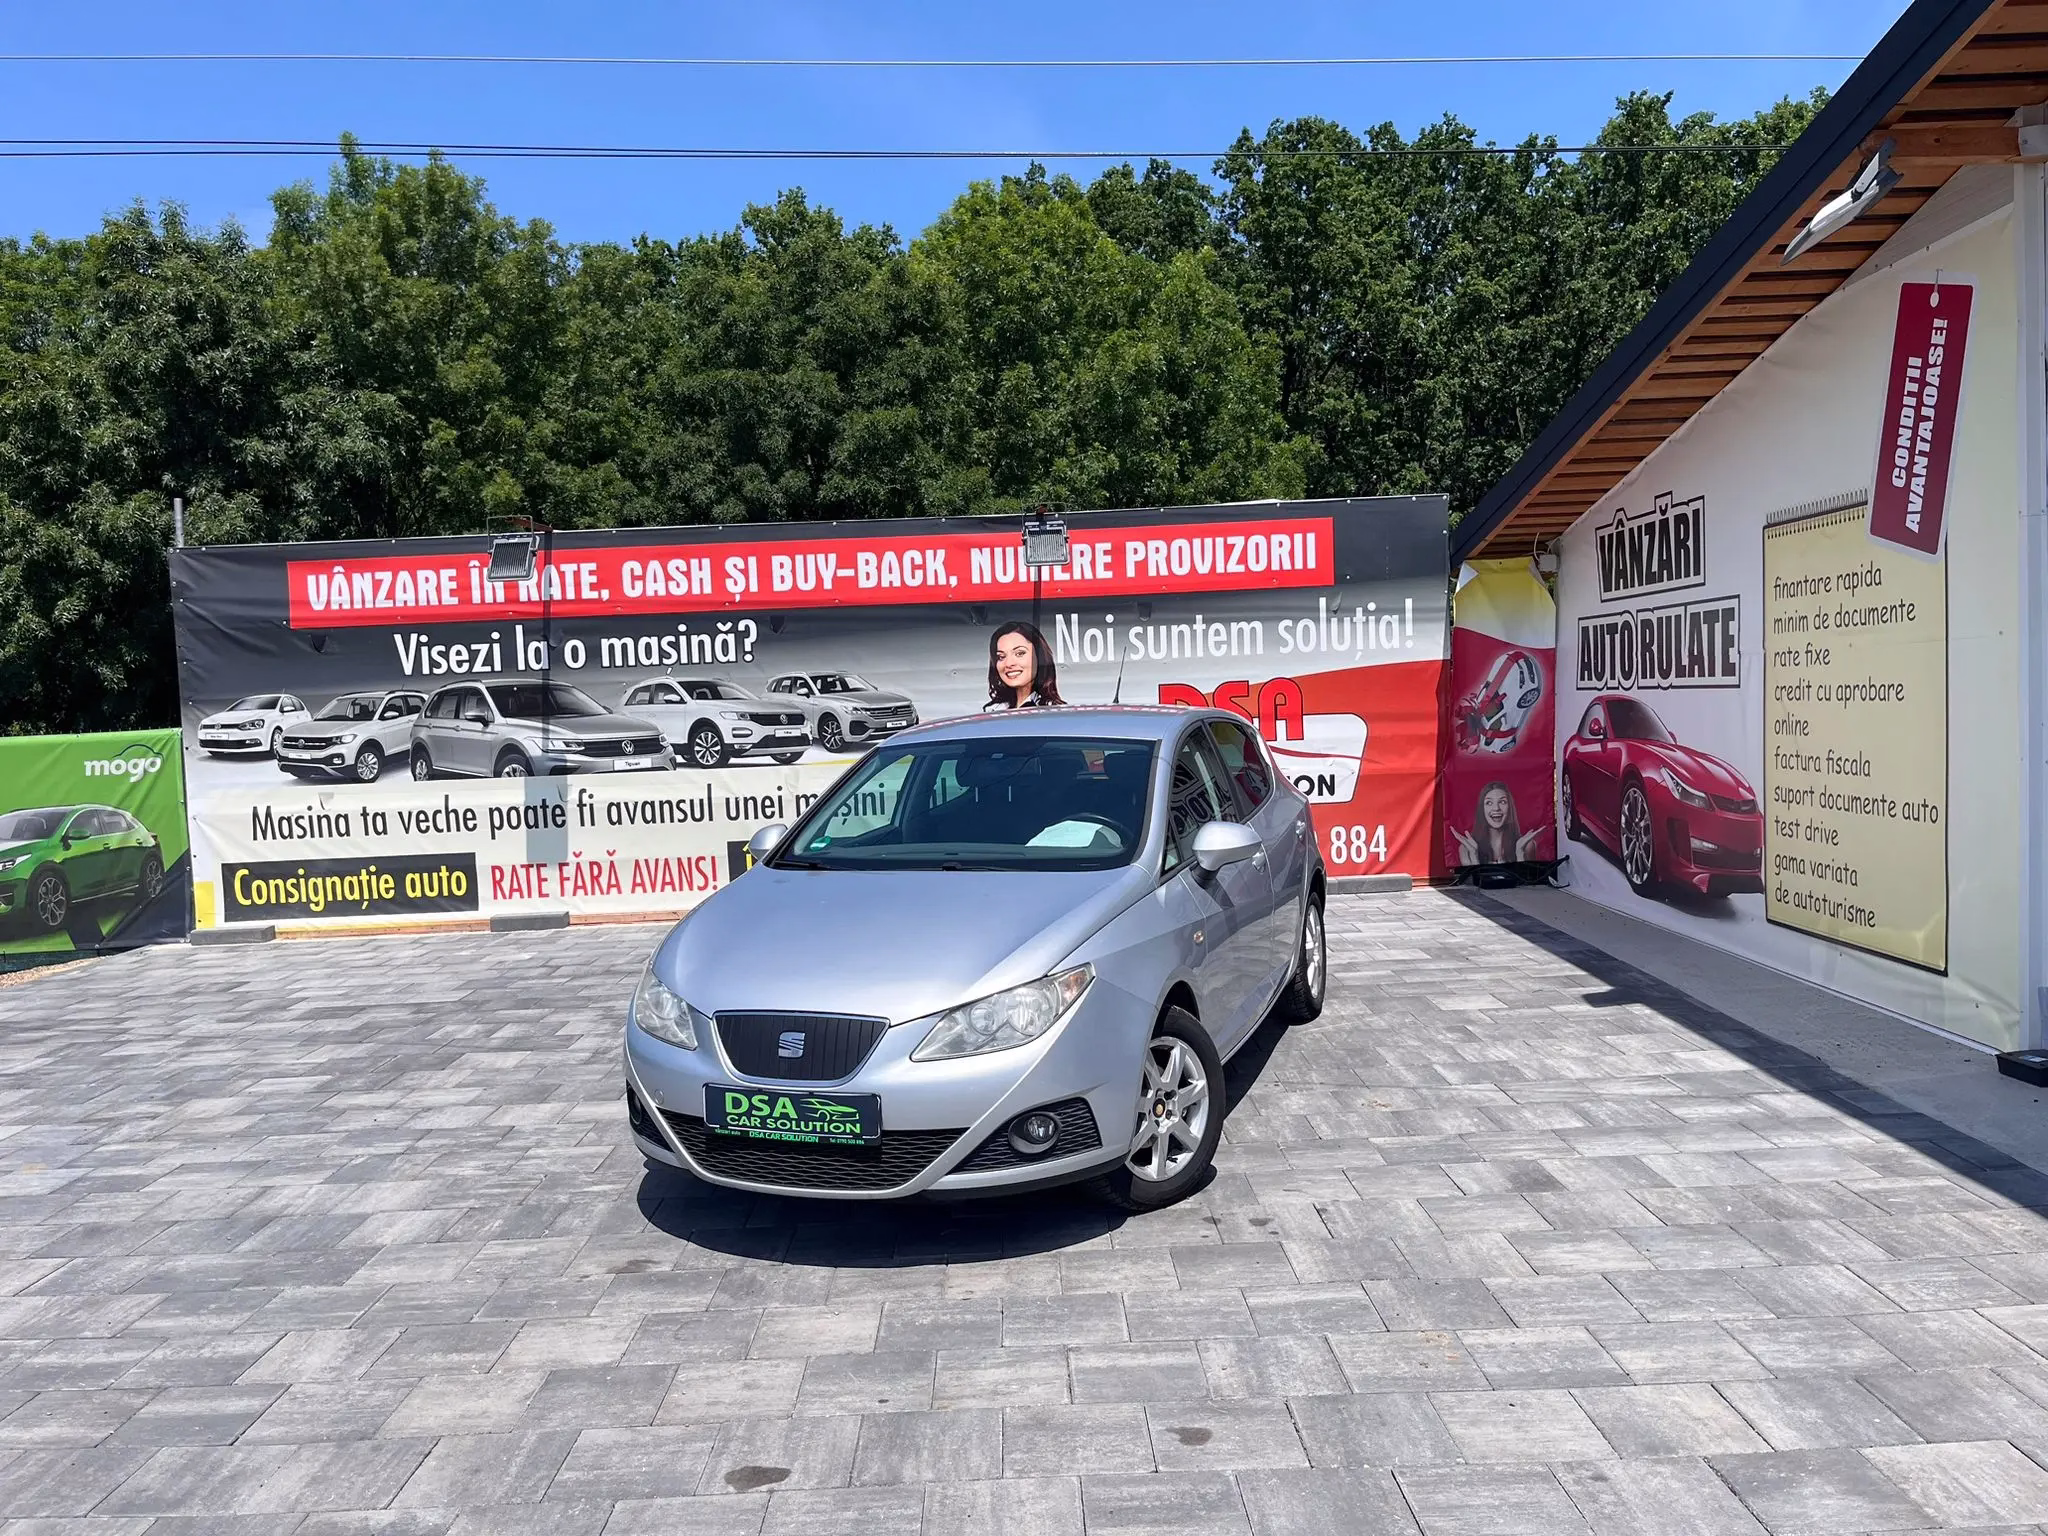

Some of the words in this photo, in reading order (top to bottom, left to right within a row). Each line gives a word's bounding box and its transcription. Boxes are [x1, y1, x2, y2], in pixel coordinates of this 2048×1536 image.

[1892, 357, 1922, 488] CONDITII
[1905, 318, 1948, 534] AVANTAJOASE!
[1599, 503, 1701, 592] VÂNZĂRI
[306, 564, 459, 611] VÂNZARE
[517, 562, 610, 603] RATE,
[621, 557, 713, 598] CASH
[724, 556, 759, 603] ȘI
[771, 548, 959, 593] BUY-BACK,
[1125, 532, 1317, 578] PROVIZORII
[1773, 576, 1832, 601] finantare
[1836, 560, 1882, 598] rapida
[1055, 613, 1115, 663] Noi
[1128, 614, 1264, 662] suntem
[1277, 597, 1414, 661] soluția!
[1773, 610, 1809, 635] minim
[1813, 605, 1830, 630] de
[1834, 598, 1916, 629] documente
[393, 631, 502, 675] Visezi
[514, 624, 549, 671] la
[564, 638, 587, 670] o
[600, 618, 759, 676] mașină?
[1580, 619, 1634, 682] AUTO
[1640, 606, 1737, 681] RULATE
[1773, 647, 1801, 668] rate
[1804, 641, 1831, 668] fixe
[1774, 677, 1812, 702] credit
[1816, 684, 1832, 702] cu
[1835, 676, 1905, 709] aprobare
[1774, 712, 1810, 737] online
[84, 756, 162, 783] mogo
[1774, 745, 1821, 773] factura
[1825, 749, 1871, 777] fiscala
[360, 806, 388, 836] ta
[398, 794, 478, 835] veche
[488, 798, 567, 840] poate
[576, 788, 595, 828] fi
[606, 783, 715, 827] avansul
[725, 786, 785, 821] unei
[1774, 785, 1815, 810] suport
[1819, 785, 1897, 818] documente
[1902, 798, 1939, 824] auto
[1330, 825, 1388, 864] 884
[1774, 815, 1800, 840] test
[1804, 818, 1839, 846] drive
[234, 864, 396, 912] Consignație
[405, 865, 467, 898] auto
[490, 861, 550, 900] RATE
[559, 849, 623, 897] FĂRĂ
[630, 855, 719, 894] AVANS!
[1774, 853, 1806, 876] gama
[1809, 859, 1858, 887] variata
[1775, 880, 1790, 905] de
[1793, 890, 1876, 928] autoturisme
[725, 1091, 798, 1119] DSA
[726, 1115, 761, 1127] CAR
[767, 1119, 861, 1134] SOLUTION
[749, 1131, 764, 1139] DSA
[765, 1132, 780, 1140] CAR
[781, 1133, 819, 1143] SOLUTION
